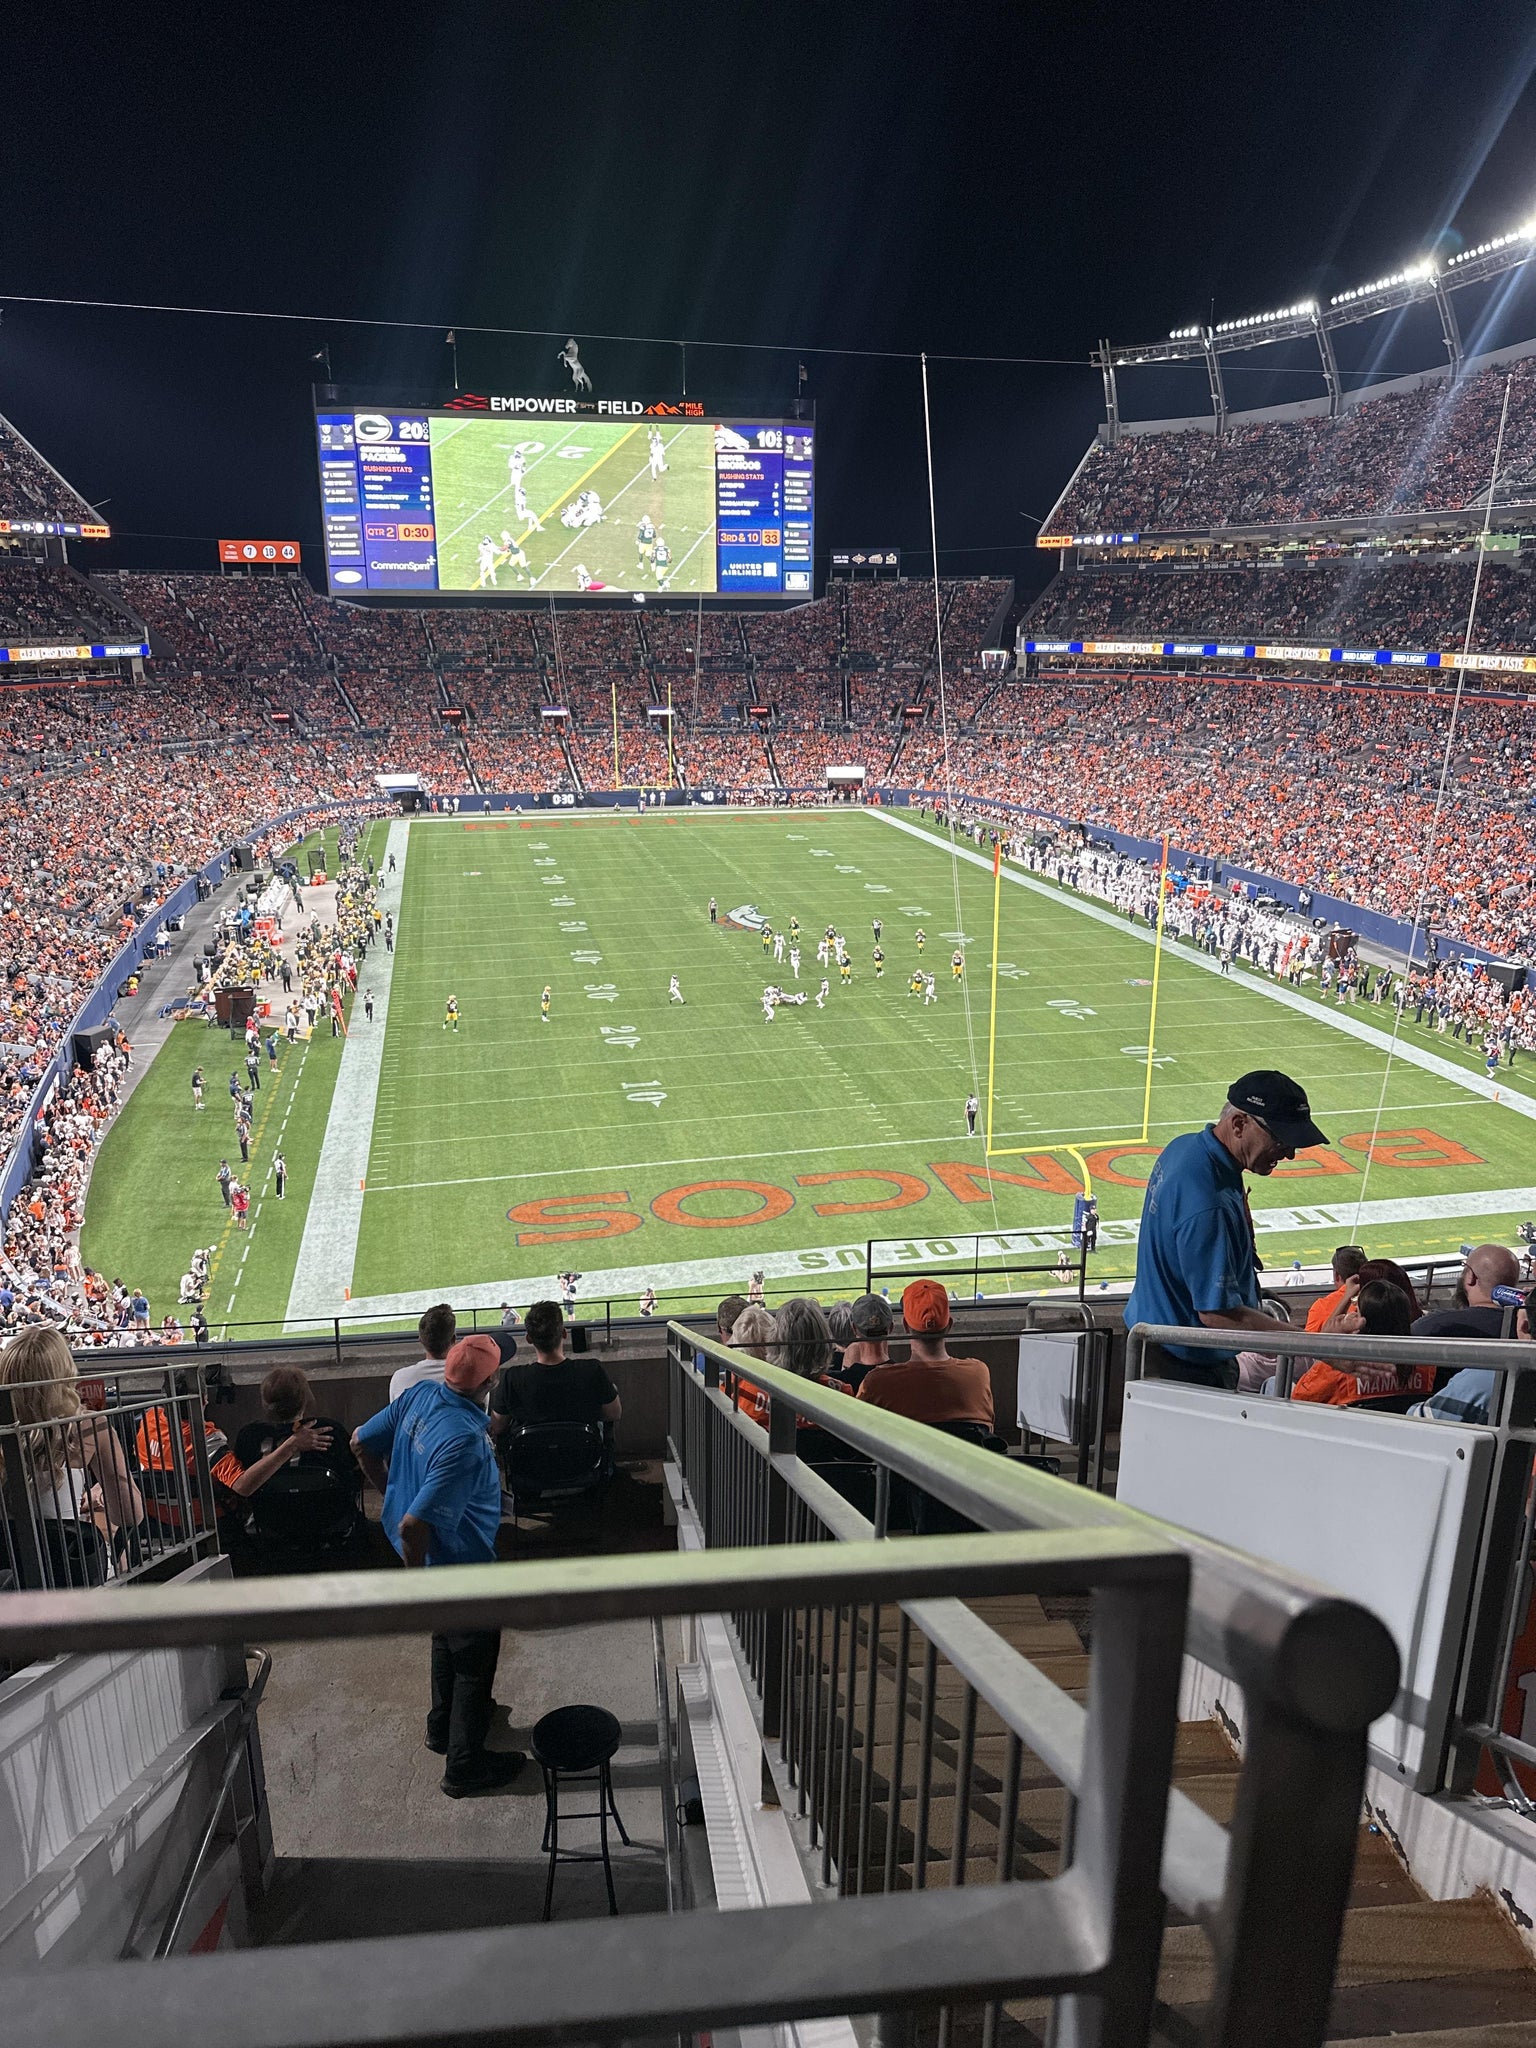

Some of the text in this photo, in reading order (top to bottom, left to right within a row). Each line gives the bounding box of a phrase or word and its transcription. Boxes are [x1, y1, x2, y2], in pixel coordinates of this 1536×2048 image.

[490, 397, 577, 413] EMPOWER
[597, 400, 644, 415] FIELD
[399, 421, 423, 440] 20
[756, 430, 777, 448] 10
[367, 527, 395, 538] QTR 2
[403, 527, 429, 538] 0:30
[720, 532, 759, 542] 3RD & 10
[765, 534, 778, 544] 33
[247, 547, 252, 556] 7
[265, 547, 274, 557] 18
[283, 548, 294, 557] 44
[370, 560, 431, 572] CommonSpirit
[105, 647, 120, 655] BUD
[1186, 646, 1204, 654] LIGHT
[1229, 647, 1245, 655] LIGHT
[1342, 651, 1375, 661] BUD LIGHT
[1392, 653, 1427, 664] BUD LIGHT
[1453, 654, 1524, 671] CLEAN CRISP TASTE
[552, 793, 574, 805] 0:30
[700, 791, 714, 801] 40
[986, 962, 1030, 977] 30
[583, 983, 620, 999] 30
[1046, 999, 1098, 1017] 20
[600, 1025, 641, 1045] 20
[1119, 1045, 1178, 1063] 10
[621, 1079, 668, 1102] 10
[1289, 1208, 1340, 1226] IT
[898, 1239, 959, 1260] OF
[797, 1248, 868, 1270] US
[1356, 1372, 1422, 1395] MANNNG
[80, 1383, 103, 1400] EDAY
